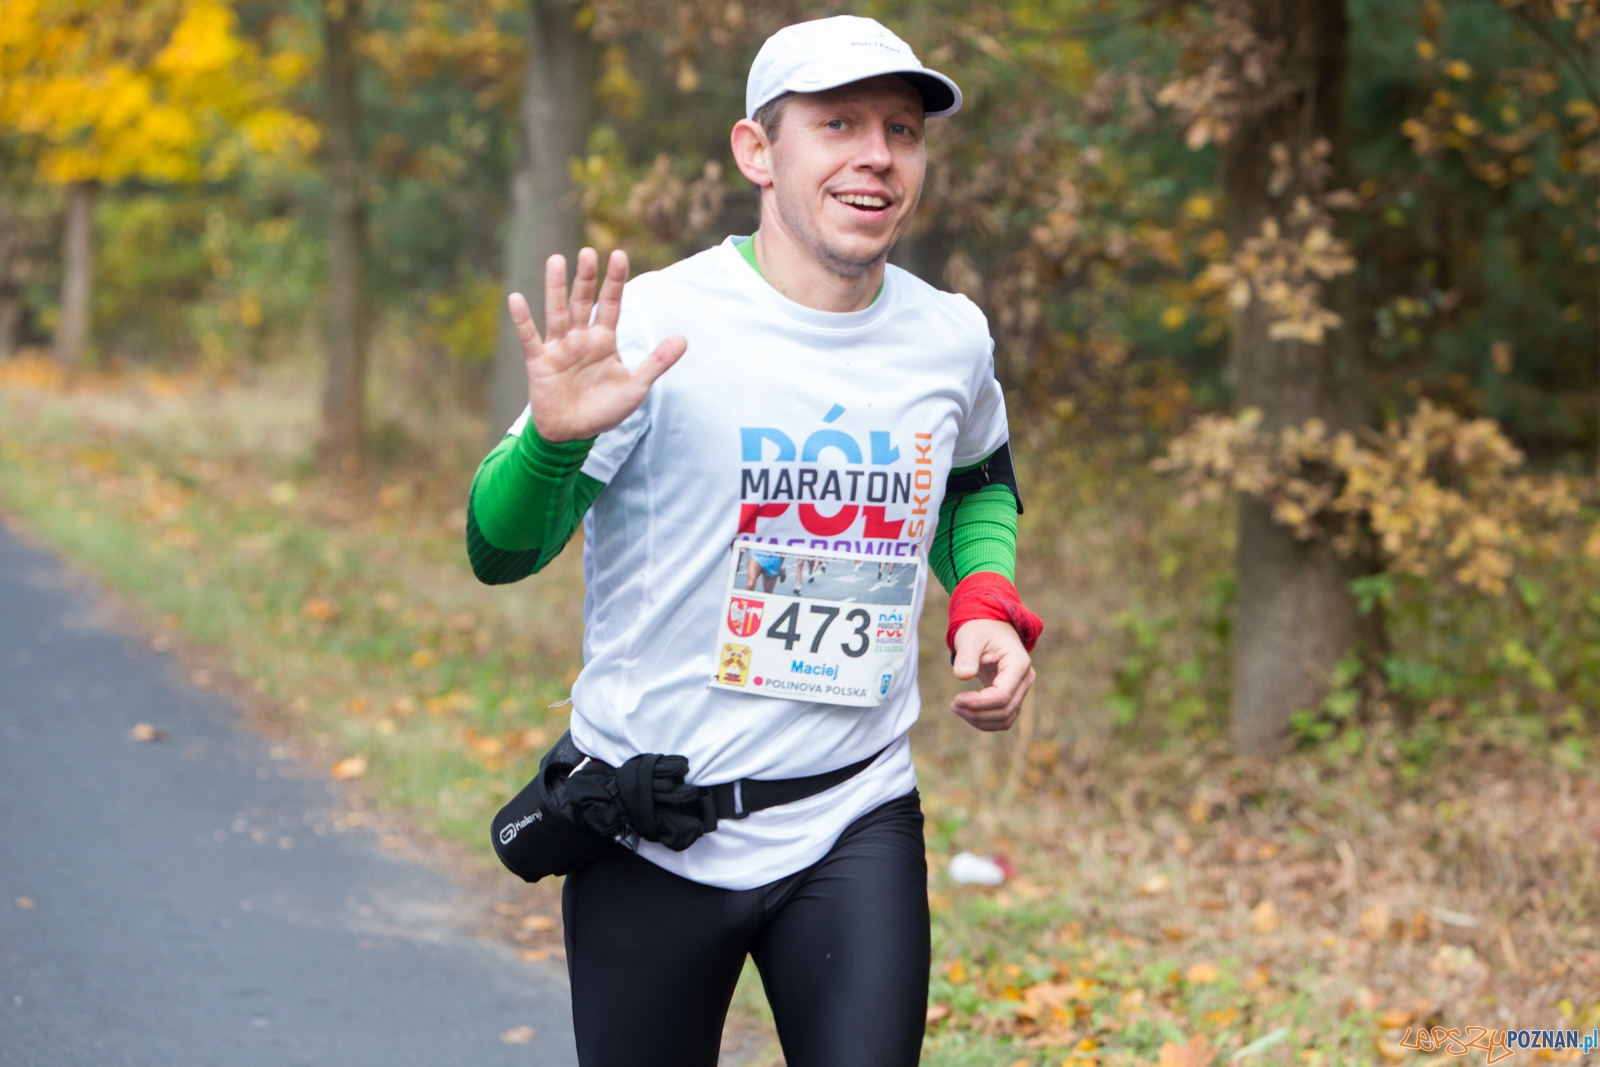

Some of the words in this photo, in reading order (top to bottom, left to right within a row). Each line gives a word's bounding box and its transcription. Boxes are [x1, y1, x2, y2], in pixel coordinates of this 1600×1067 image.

[740, 468, 912, 504] MARATON
[908, 432, 933, 539] SKOKI
[766, 601, 871, 659] 473
[790, 660, 839, 680] Maciej
[765, 677, 823, 693] POLINOVA
[825, 681, 868, 698] POLSKA
[515, 809, 543, 831] Kalenji
